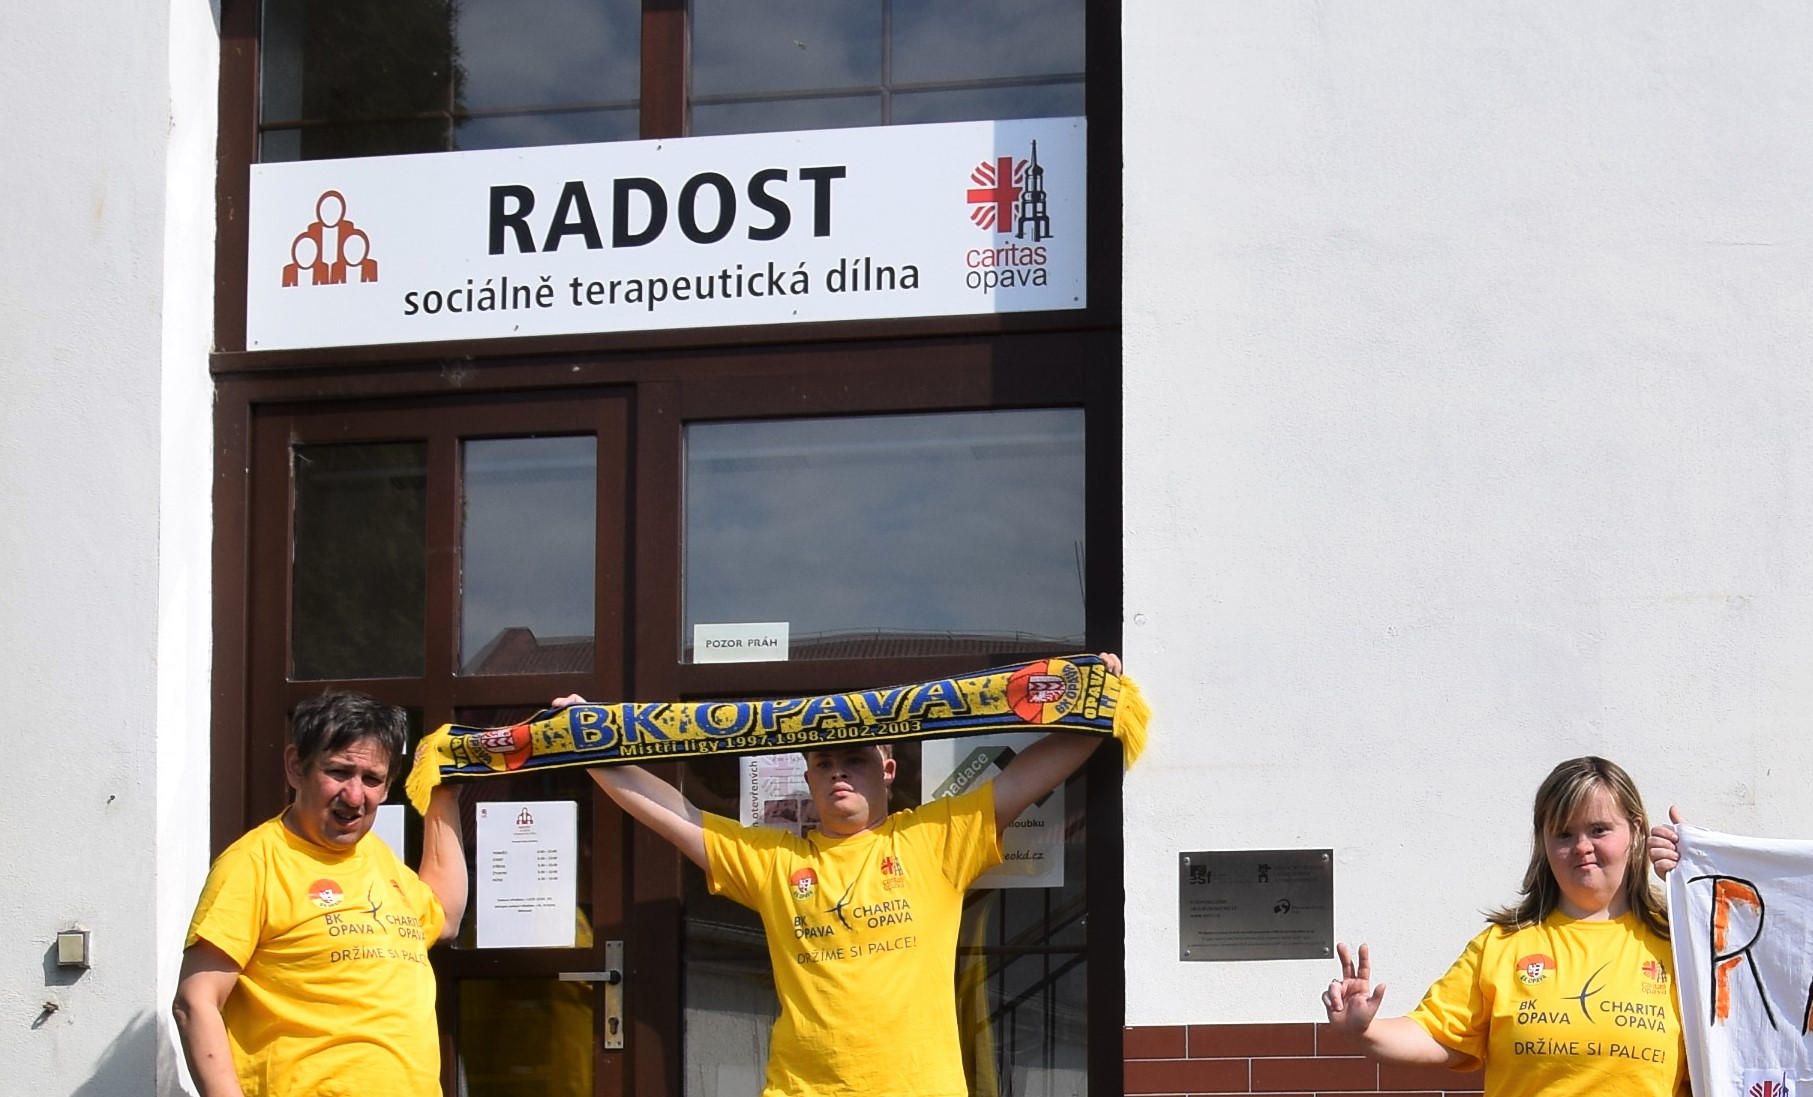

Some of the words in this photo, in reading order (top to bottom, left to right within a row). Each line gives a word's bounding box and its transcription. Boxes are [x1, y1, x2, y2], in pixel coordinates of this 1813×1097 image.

[487, 165, 847, 256] RADOST
[966, 241, 1047, 268] caritas
[404, 275, 555, 316] sociálně
[569, 262, 810, 312] terapeutická
[826, 256, 920, 293] dílna
[966, 267, 1048, 292] opava
[705, 639, 742, 648] POZOR
[747, 636, 778, 647] PRÁH
[1084, 664, 1105, 719] OPAVA
[568, 703, 674, 751] BK
[694, 679, 968, 738] OPAVA
[620, 740, 675, 757] Mistři
[685, 738, 719, 753] ligy
[726, 720, 922, 749] 1997,1998,2002,2003
[942, 752, 989, 799] nadace
[748, 760, 759, 819] otevřených
[1003, 850, 1043, 860] eokd.cz
[852, 898, 911, 919] CHARITA
[325, 913, 343, 926] BK
[794, 916, 808, 928] BK
[867, 911, 913, 929] OPAVA
[328, 923, 374, 937] OPAVA
[794, 925, 835, 940] OPAVA
[330, 945, 385, 963] DRŽÍME
[387, 949, 400, 959] SI
[797, 948, 845, 965] DRŽÍME
[850, 946, 863, 958] SI
[868, 936, 917, 955] PALCE!
[1519, 999, 1537, 1011] BK
[1599, 1000, 1666, 1019] CHARITA
[1517, 1012, 1571, 1025] OPAVA
[1614, 1014, 1666, 1033] OPAVA
[1514, 1038, 1580, 1056] DRŽÍME
[1587, 1042, 1601, 1056] SI
[1609, 1043, 1666, 1064] PALCE!
